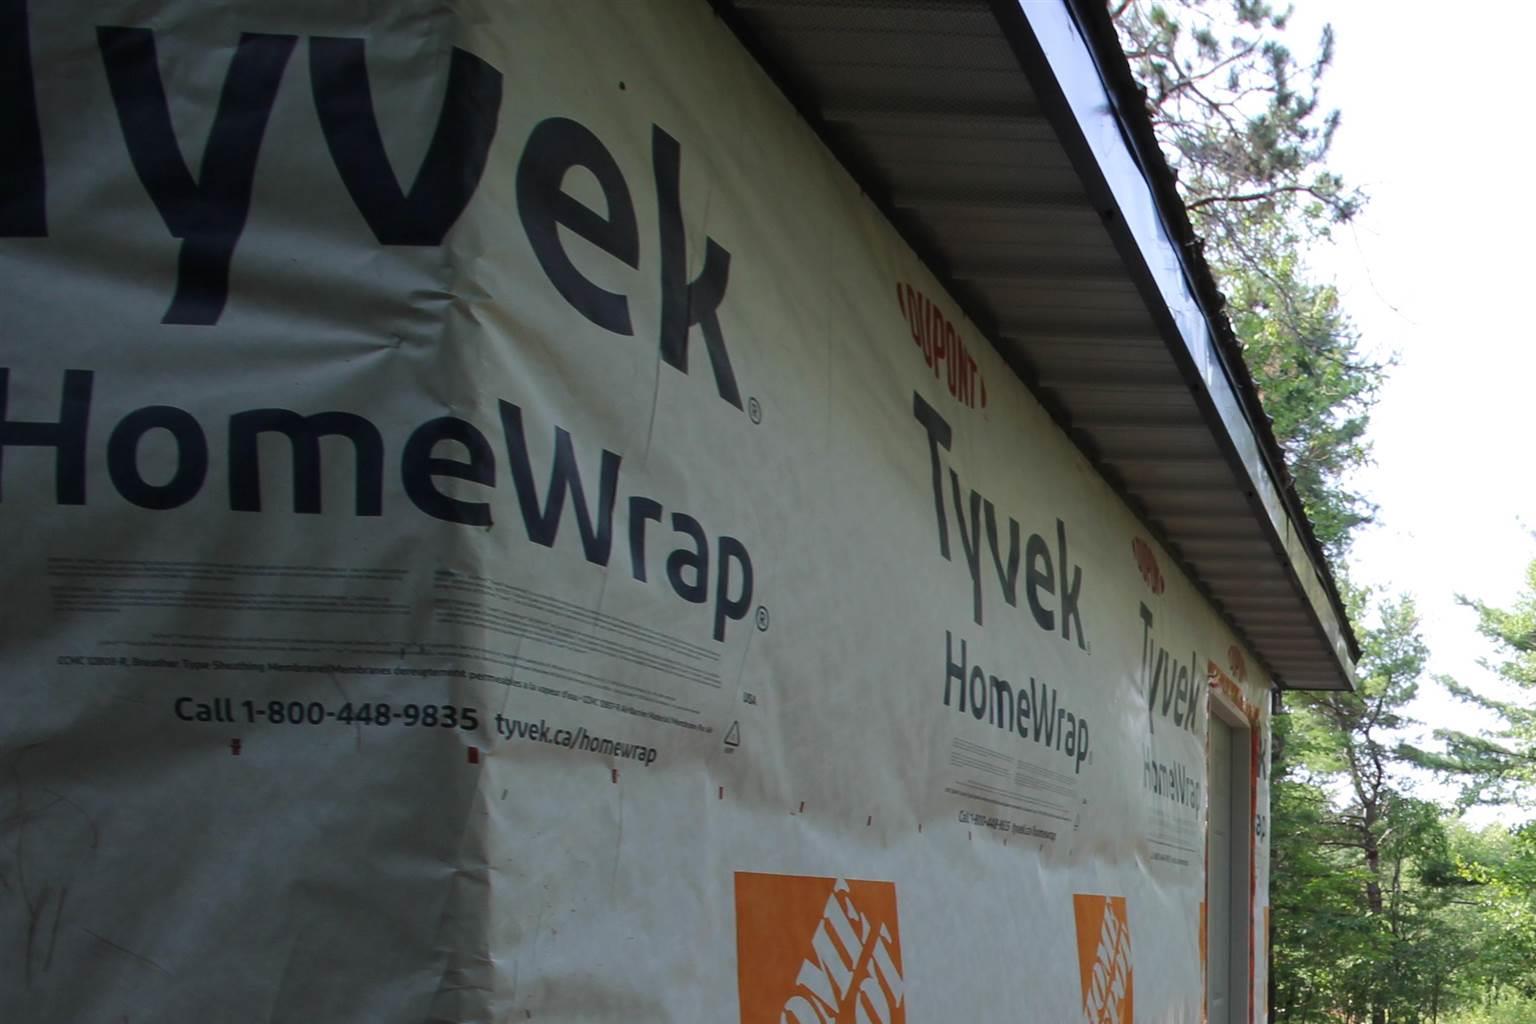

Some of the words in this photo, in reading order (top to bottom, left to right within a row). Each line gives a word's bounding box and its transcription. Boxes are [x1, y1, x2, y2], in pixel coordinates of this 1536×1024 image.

[907, 284, 978, 410] DUPONT
[0, 368, 754, 642] HomeWrap
[913, 390, 1087, 651] Tyvek
[175, 697, 234, 723] Call
[242, 700, 478, 731] 1-800-448-9835
[495, 713, 657, 767] tyvek.ca/homewrap
[943, 630, 1090, 774] HomeWrap
